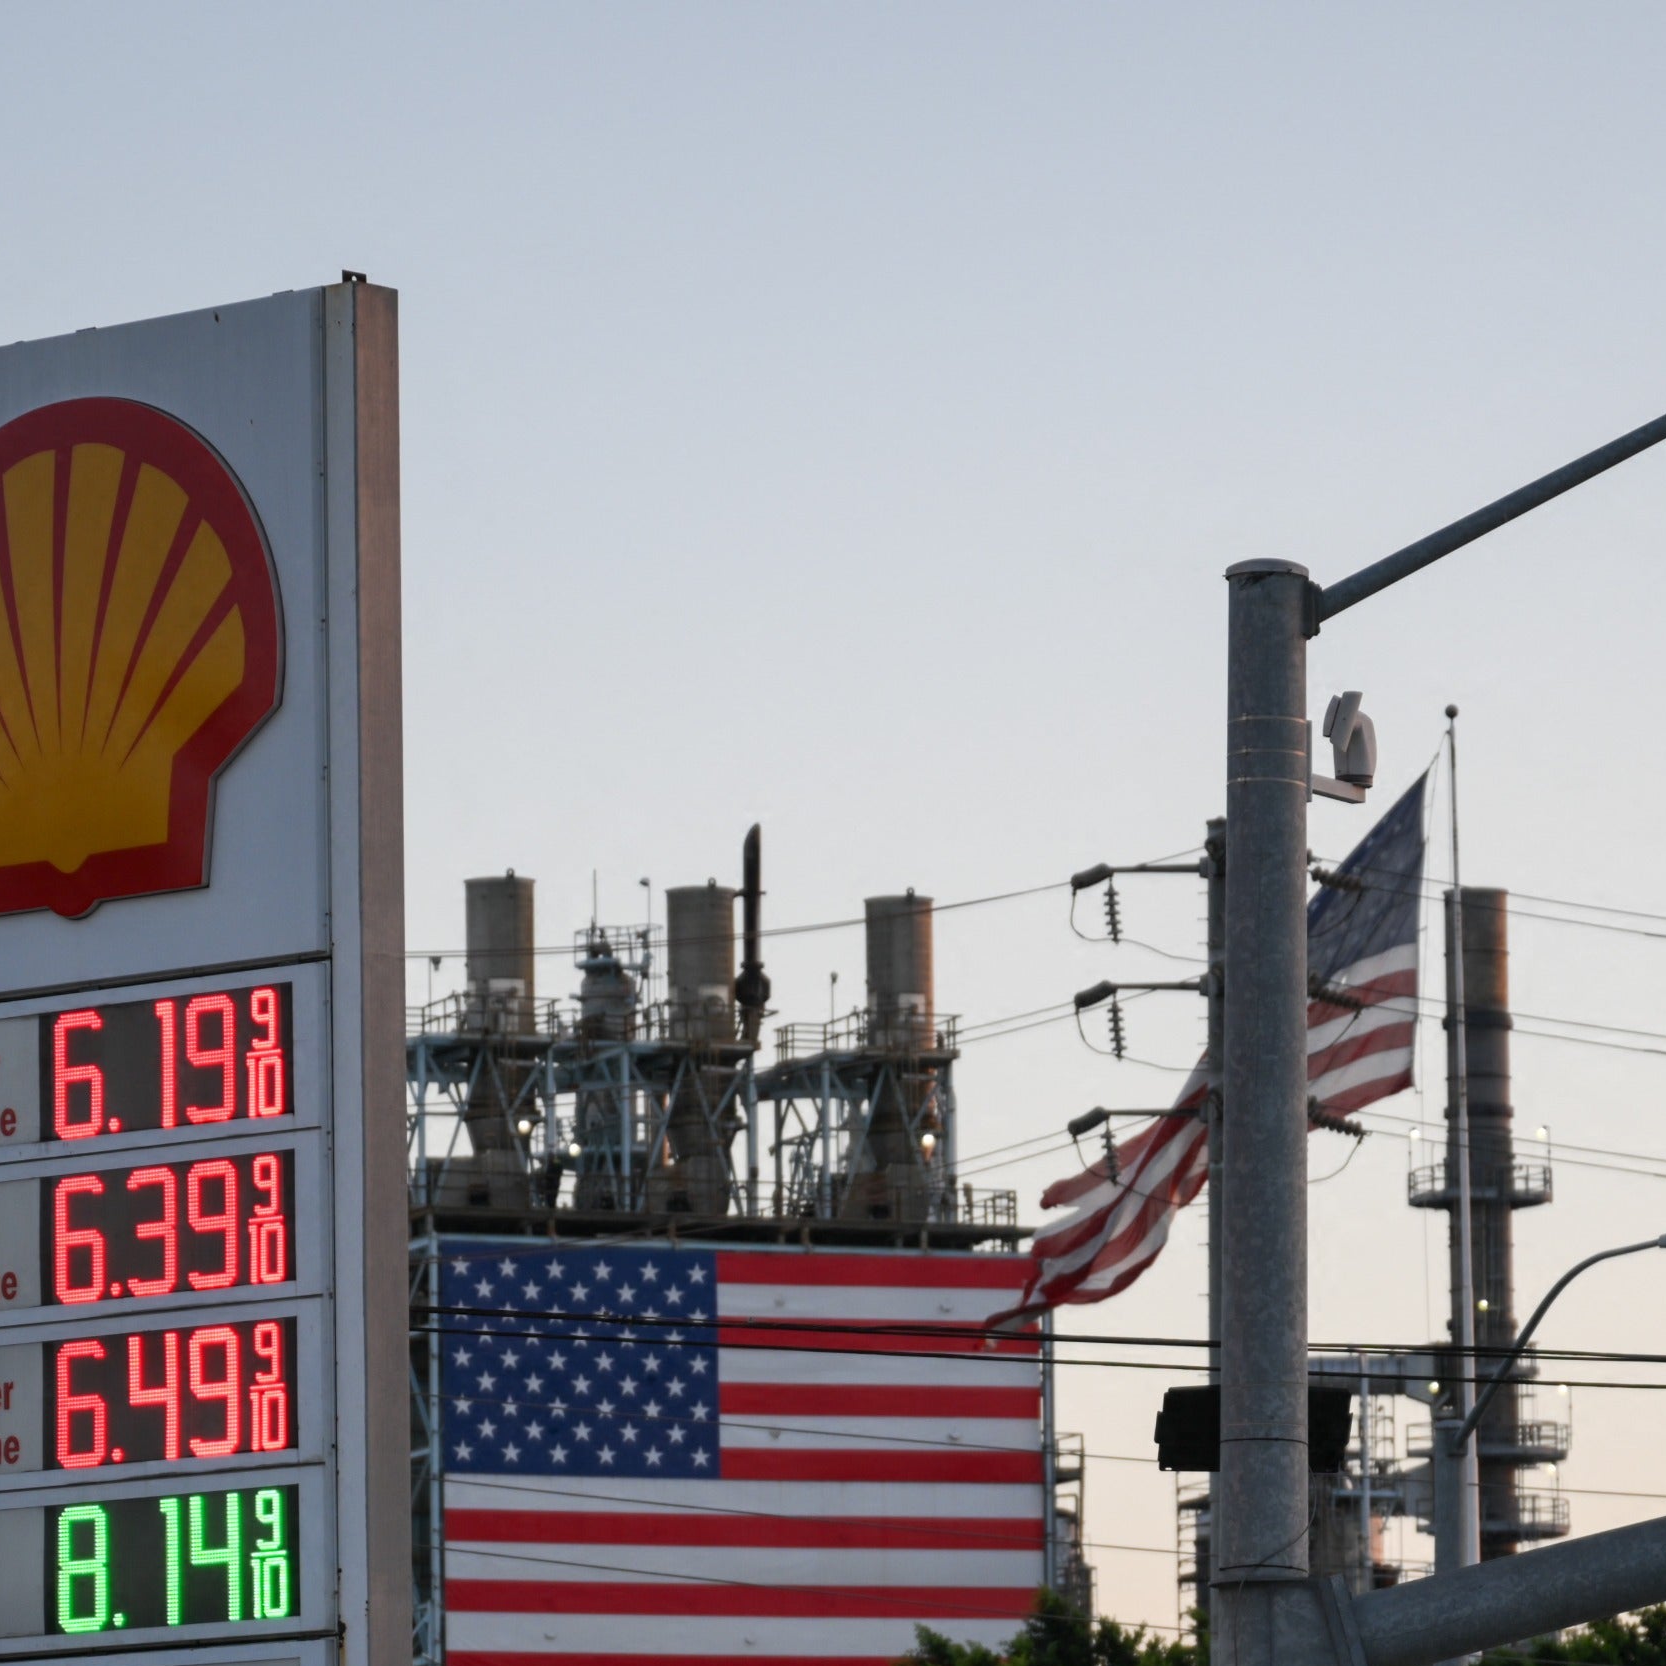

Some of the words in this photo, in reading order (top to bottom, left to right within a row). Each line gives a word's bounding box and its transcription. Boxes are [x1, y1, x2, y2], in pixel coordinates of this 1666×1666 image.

[53, 993, 235, 1141] 6.19
[54, 1159, 237, 1304] 6.39
[56, 1325, 239, 1470] 6.49
[57, 1491, 239, 1633] 8.14
